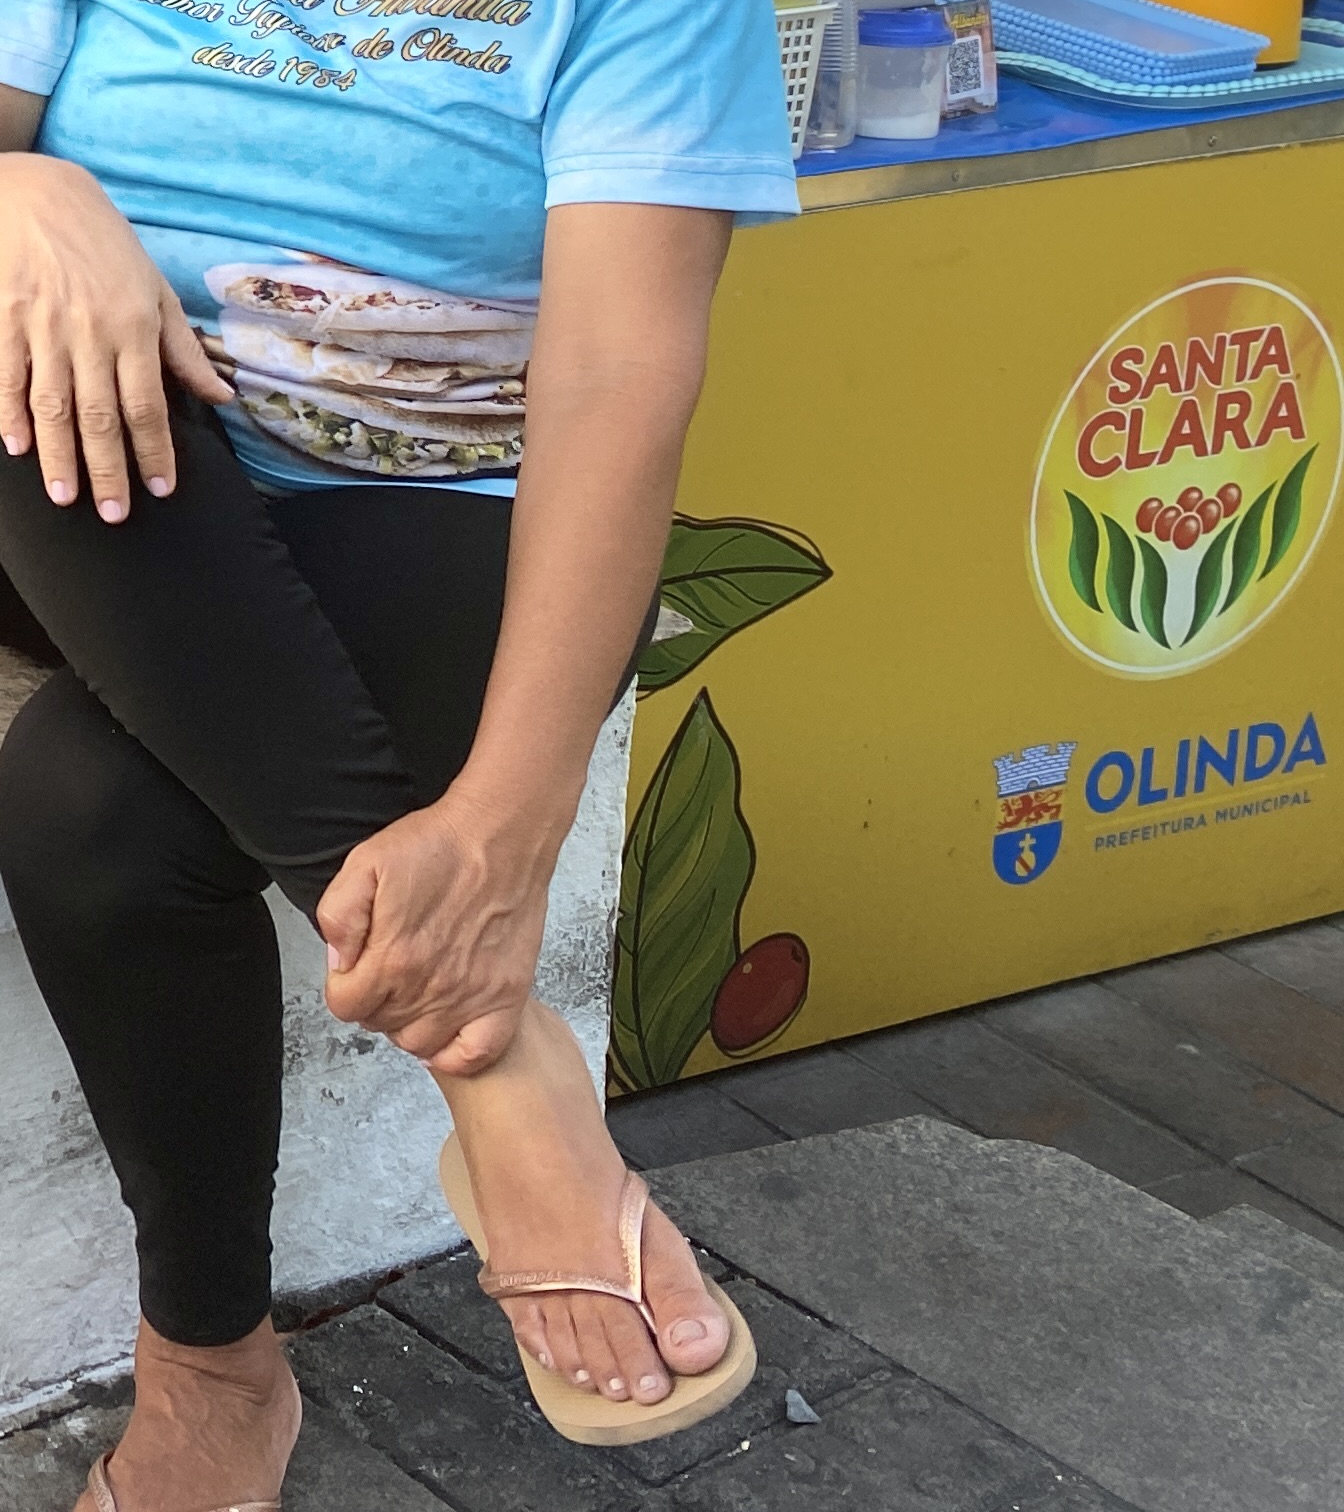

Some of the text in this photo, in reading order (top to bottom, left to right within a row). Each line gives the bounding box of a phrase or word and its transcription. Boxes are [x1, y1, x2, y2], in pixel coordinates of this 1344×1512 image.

[192, 42, 357, 92] desde 1984
[351, 27, 395, 60] de
[400, 27, 513, 74] Olinda
[1107, 324, 1293, 405] SANTA
[1076, 380, 1306, 478] CLARA
[1085, 711, 1327, 814] OLINDA
[1094, 790, 1312, 852] PREFEITURA MUNICIPAL
